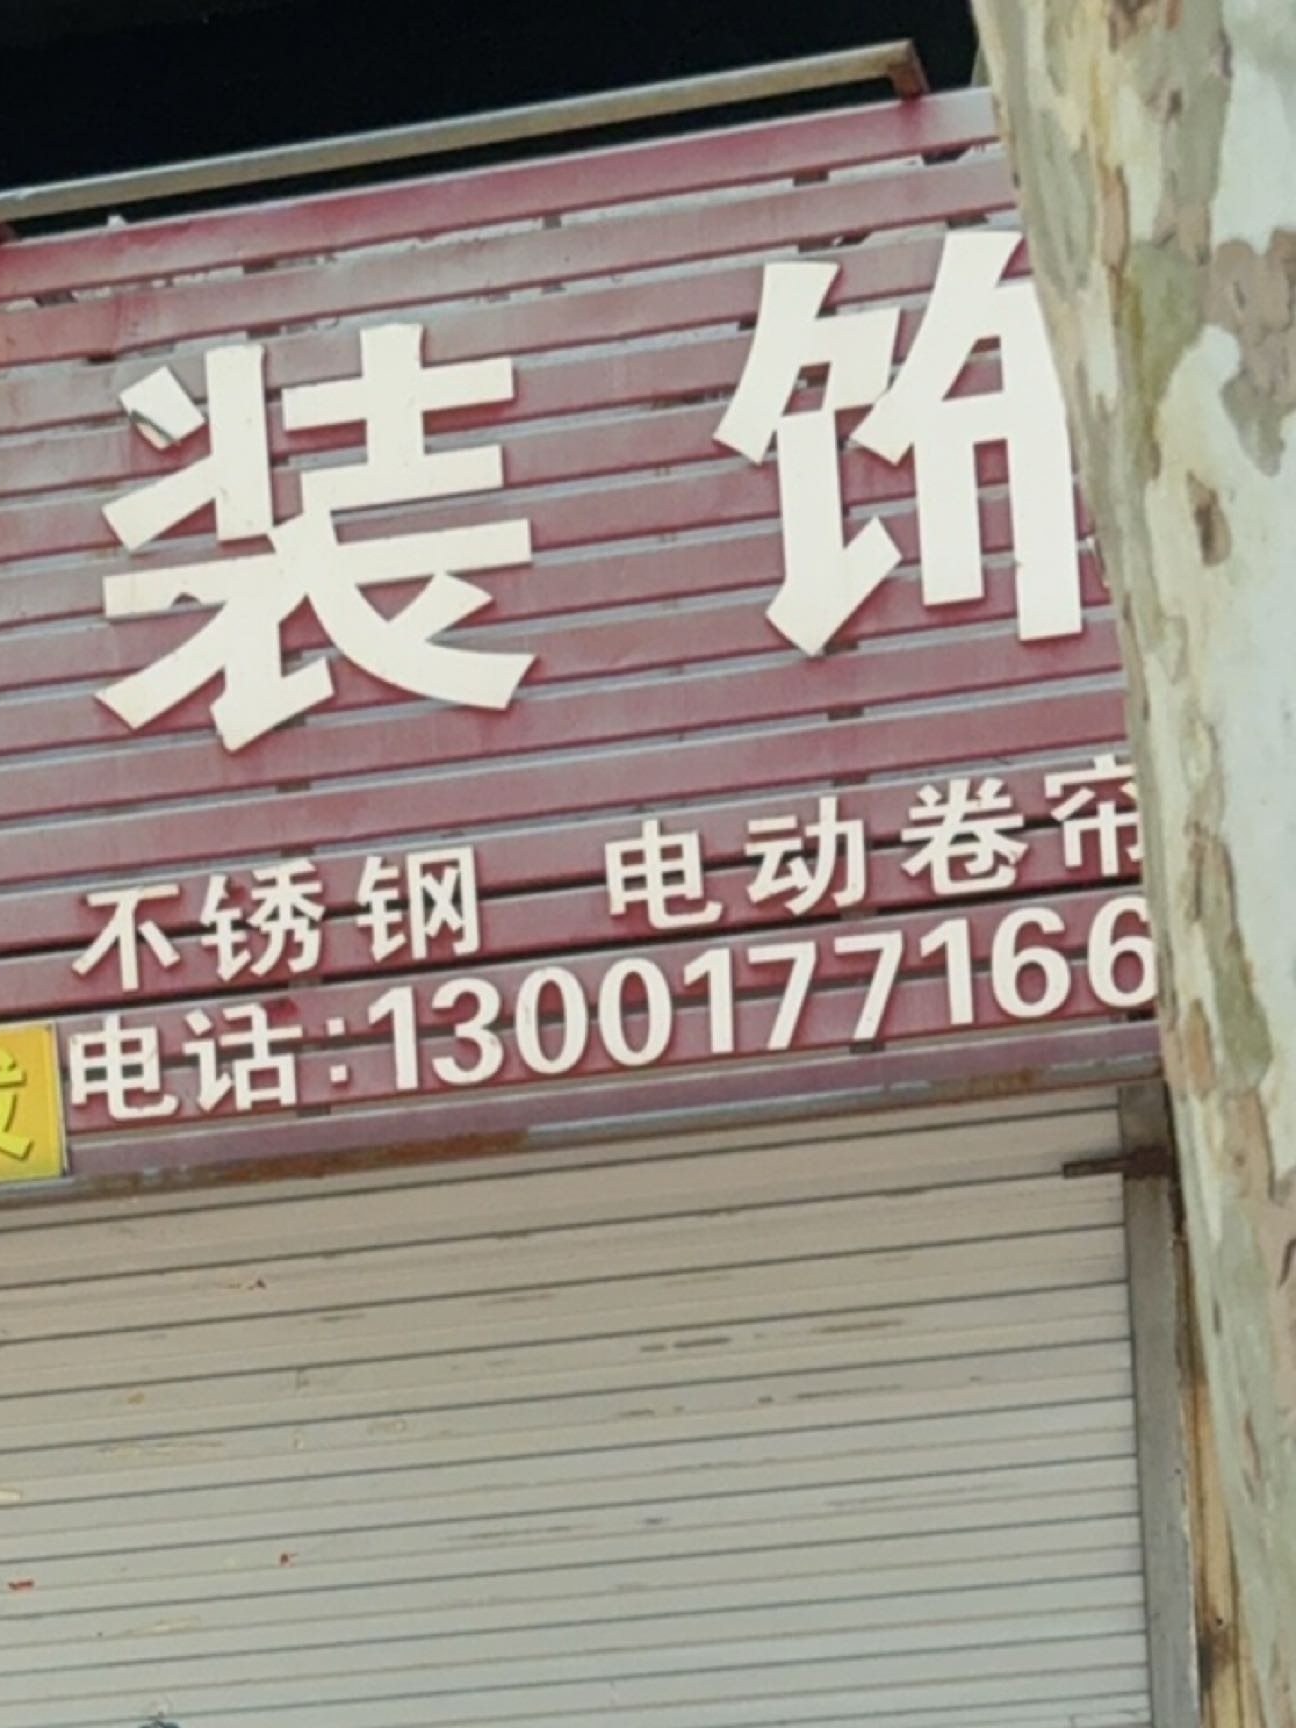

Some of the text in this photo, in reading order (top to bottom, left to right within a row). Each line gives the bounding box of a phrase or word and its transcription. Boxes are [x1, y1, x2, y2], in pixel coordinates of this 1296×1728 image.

[71, 845, 480, 993] 不锈钢
[604, 753, 1144, 930] 电动卷帘
